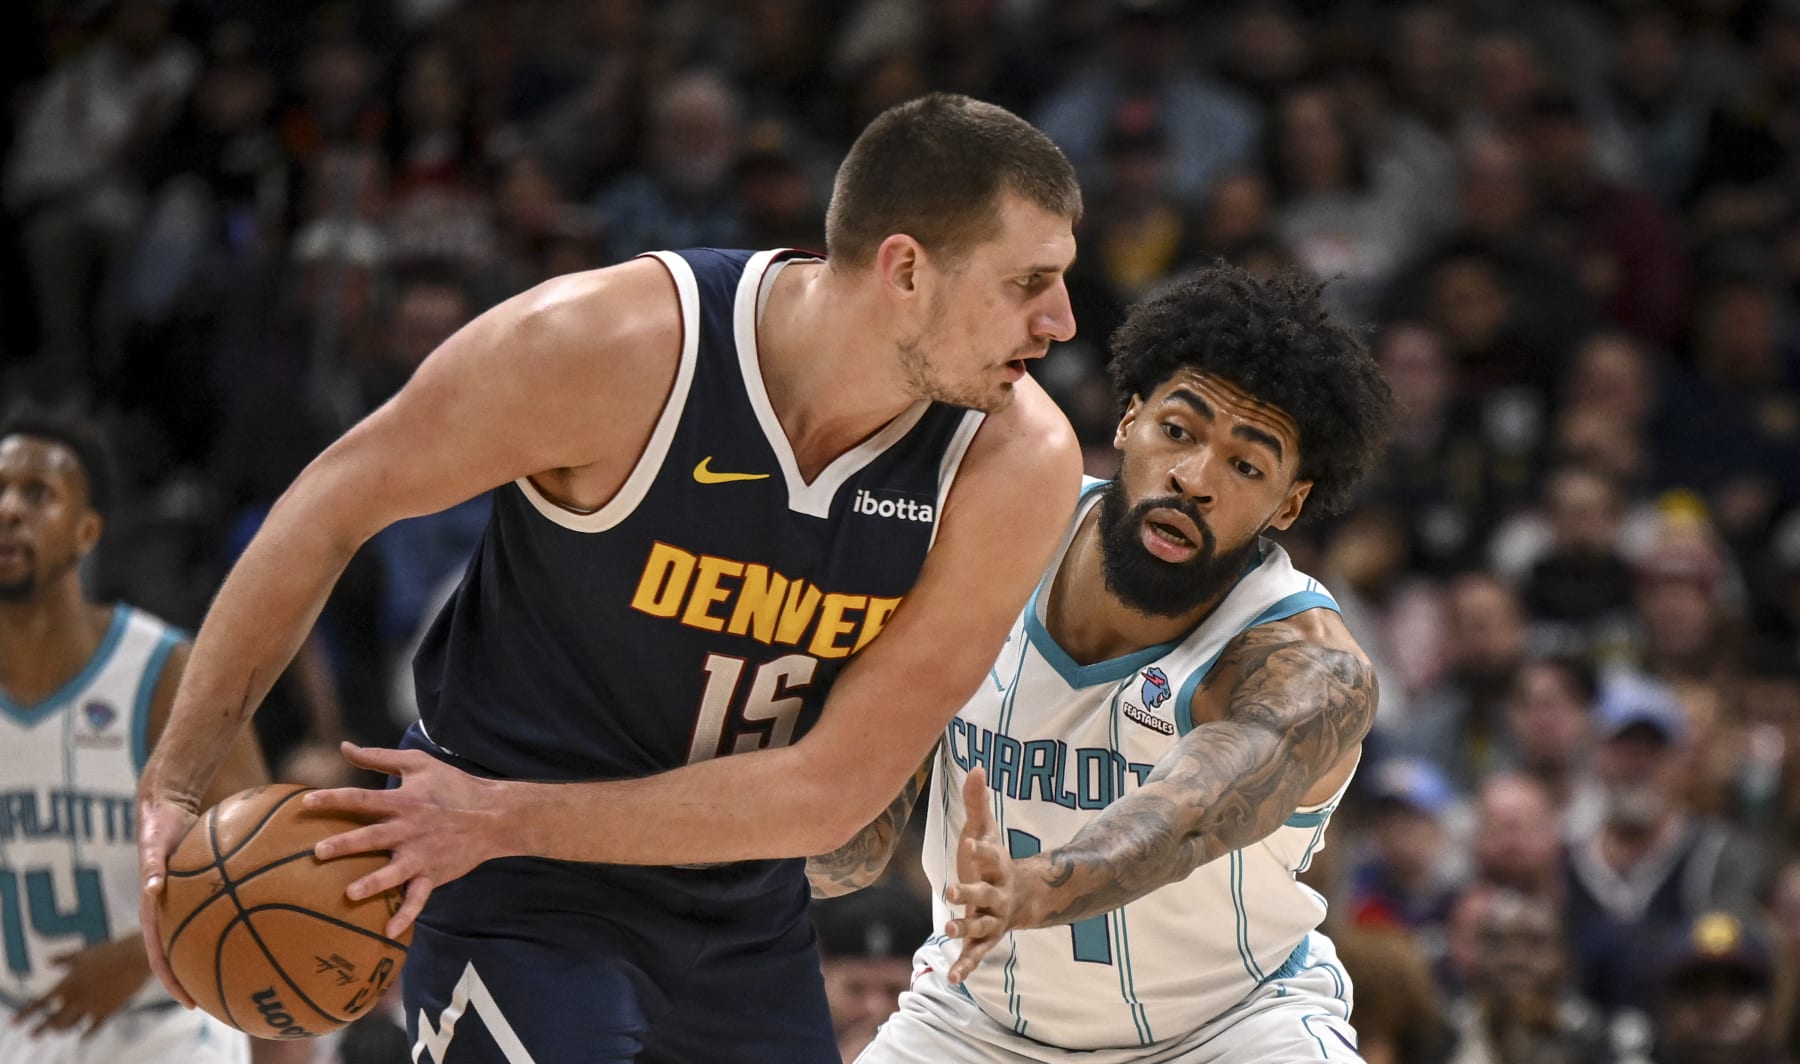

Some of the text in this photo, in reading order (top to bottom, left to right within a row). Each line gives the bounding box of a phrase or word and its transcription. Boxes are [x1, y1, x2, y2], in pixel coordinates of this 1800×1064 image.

[853, 489, 934, 523] ibotta
[686, 652, 819, 767] 15
[1123, 702, 1175, 736] FEASTABLES
[0, 868, 111, 977] 14
